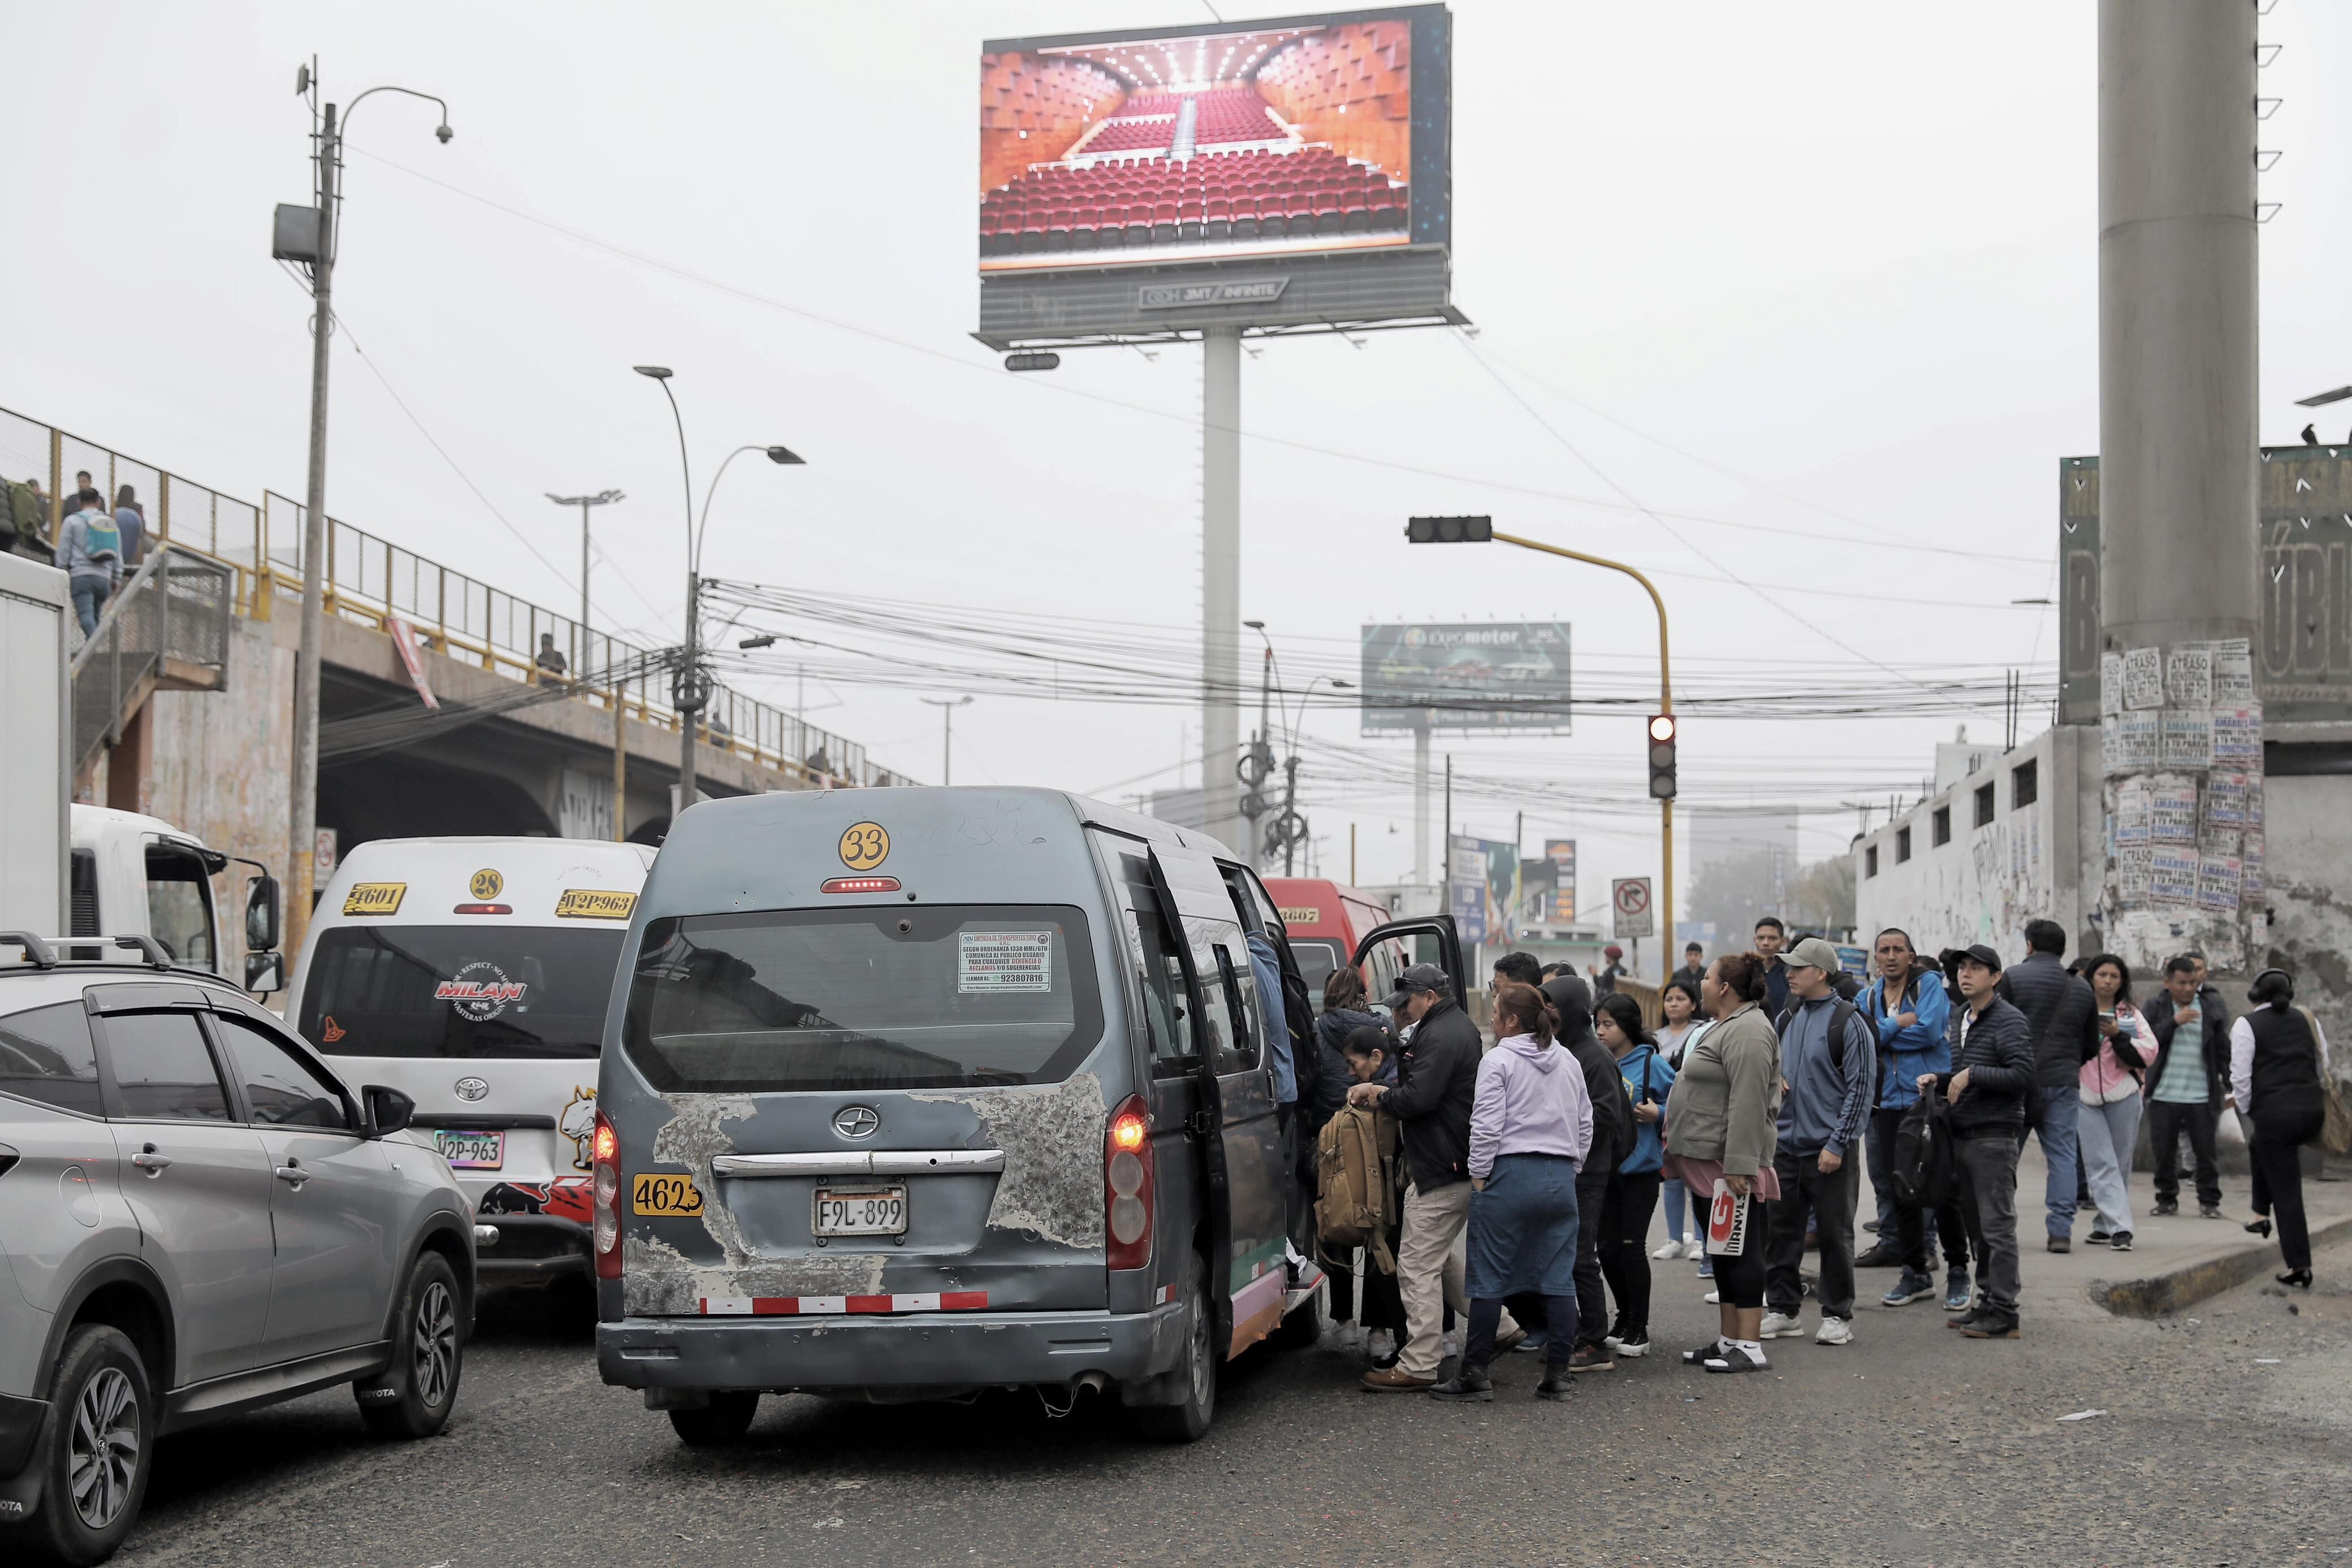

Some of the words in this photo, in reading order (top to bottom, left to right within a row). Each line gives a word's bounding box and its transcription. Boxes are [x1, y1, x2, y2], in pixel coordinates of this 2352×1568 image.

[845, 829, 883, 861] 33
[475, 874, 499, 894] 28
[354, 887, 397, 904] 4601
[461, 961, 492, 974] RESPECT
[1001, 974, 1043, 982] 923807816
[434, 981, 528, 1003] MILAN
[438, 1141, 499, 1161] W2P-963
[820, 1199, 902, 1227] F9L-899
[361, 1388, 396, 1397] TOYOTA
